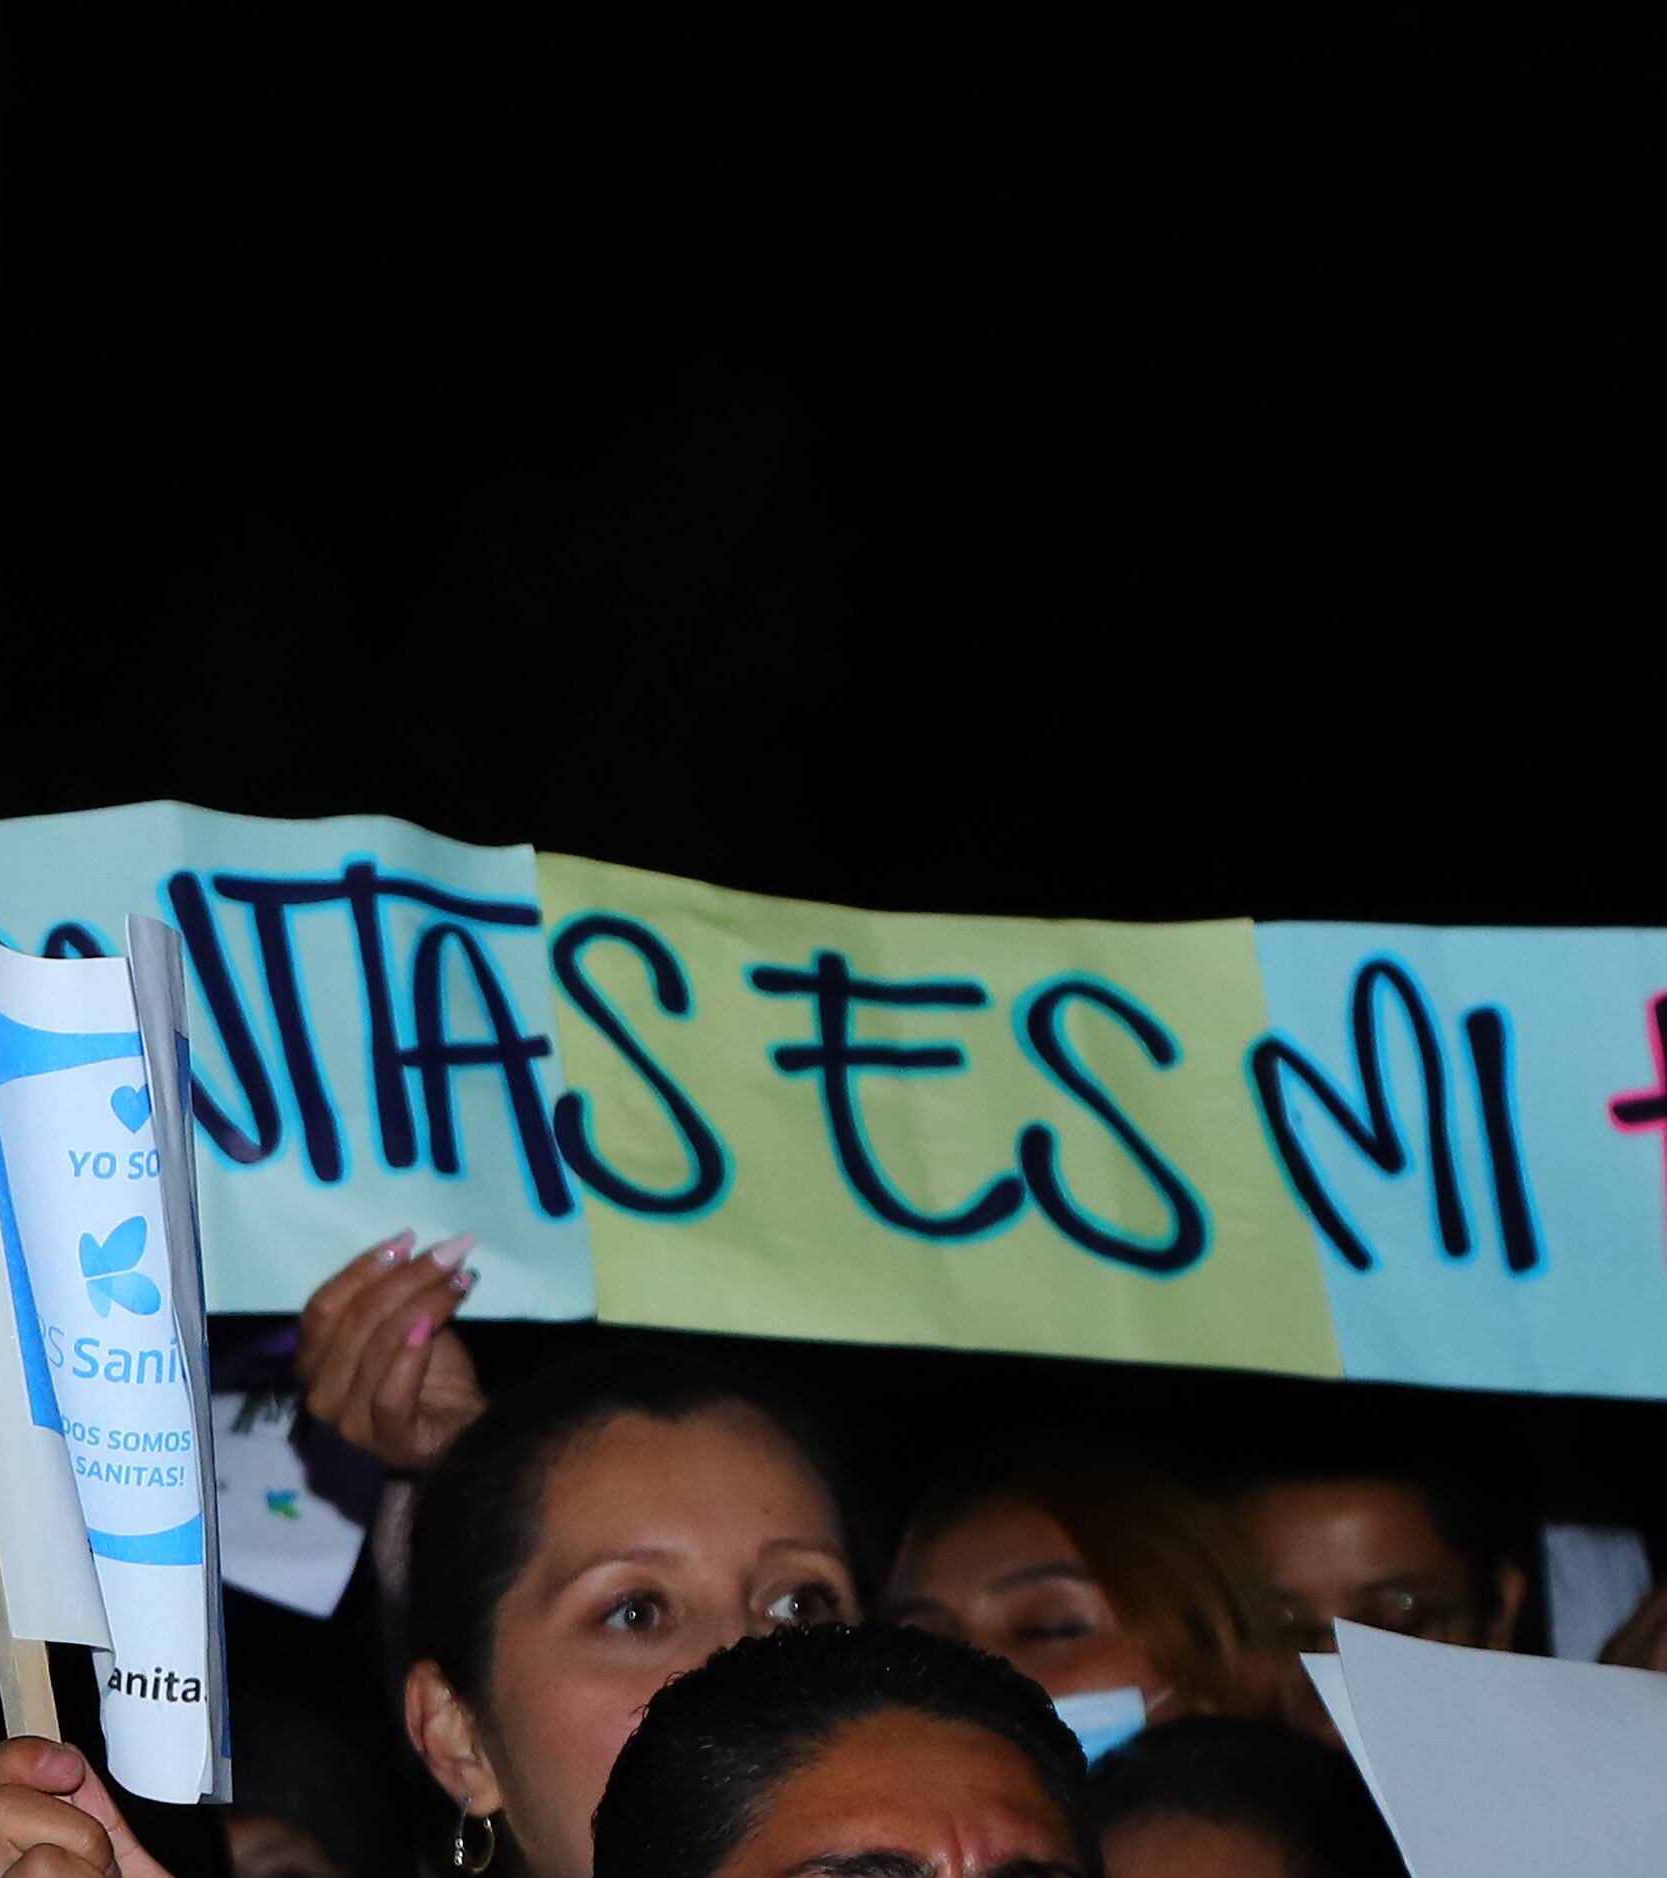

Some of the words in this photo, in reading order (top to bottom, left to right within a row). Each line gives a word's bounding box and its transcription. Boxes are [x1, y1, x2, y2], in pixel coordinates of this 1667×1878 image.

[750, 949, 1208, 1275] ES
[1252, 956, 1541, 1275] MI
[67, 1149, 117, 1180] YO
[127, 1149, 161, 1180] SO
[107, 1430, 192, 1453] SOMOS
[75, 1455, 186, 1488] SANITAS!
[107, 1666, 208, 1703] anita
